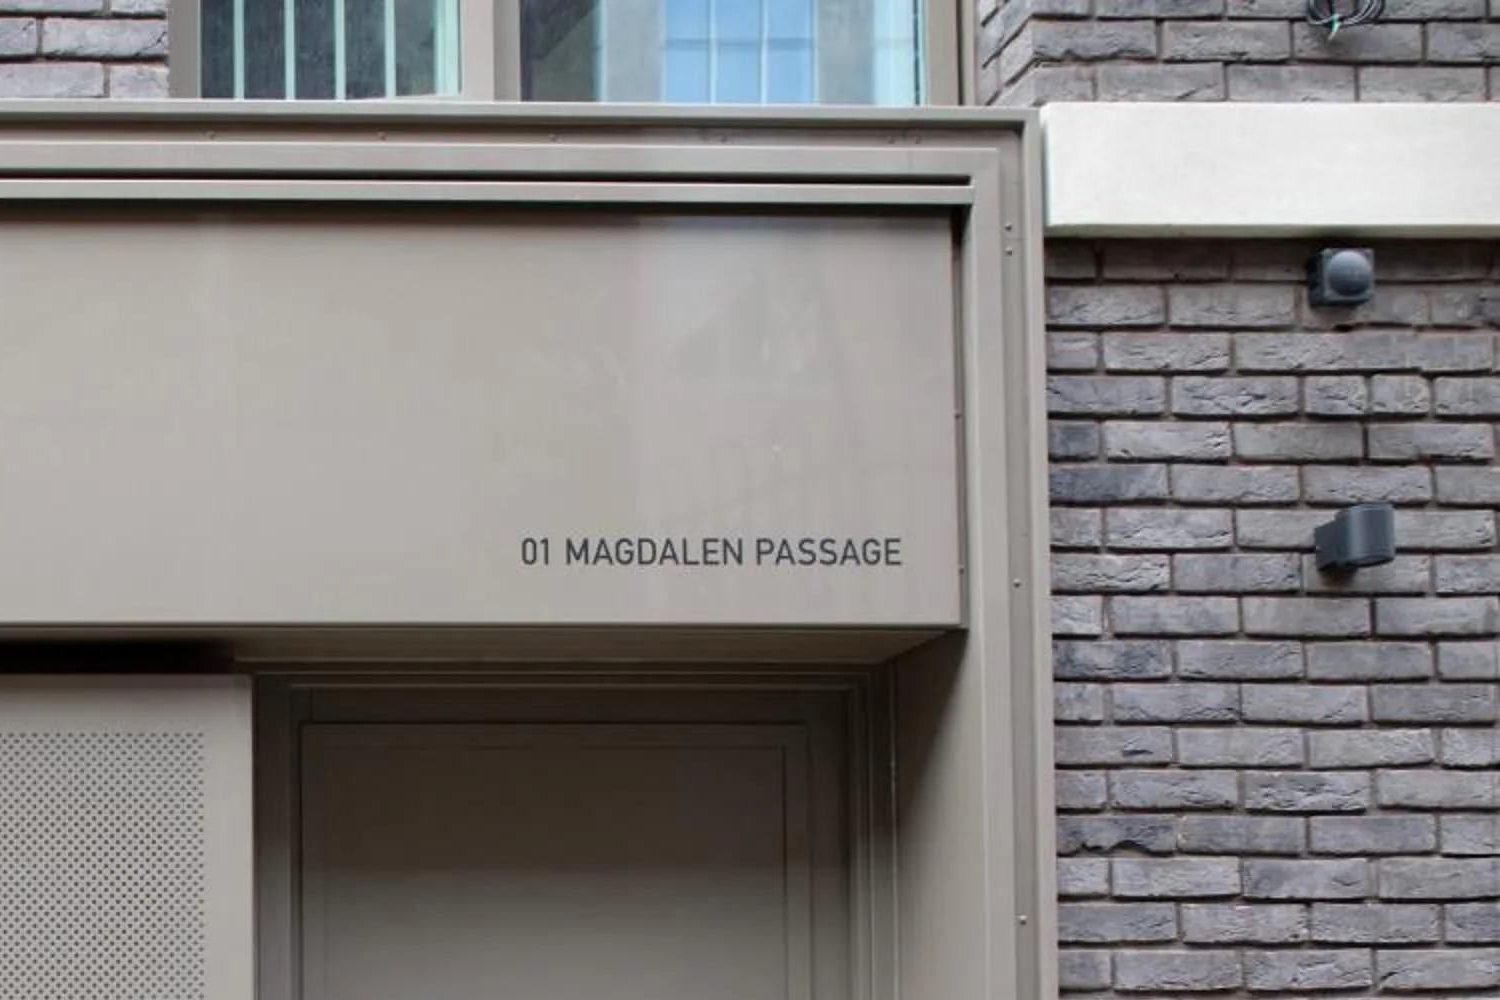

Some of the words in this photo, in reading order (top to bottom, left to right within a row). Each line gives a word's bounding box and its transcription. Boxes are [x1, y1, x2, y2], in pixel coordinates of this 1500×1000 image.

[520, 537, 550, 566] 01
[565, 537, 743, 566] MAGDALEN
[756, 537, 902, 566] PASSAGE
